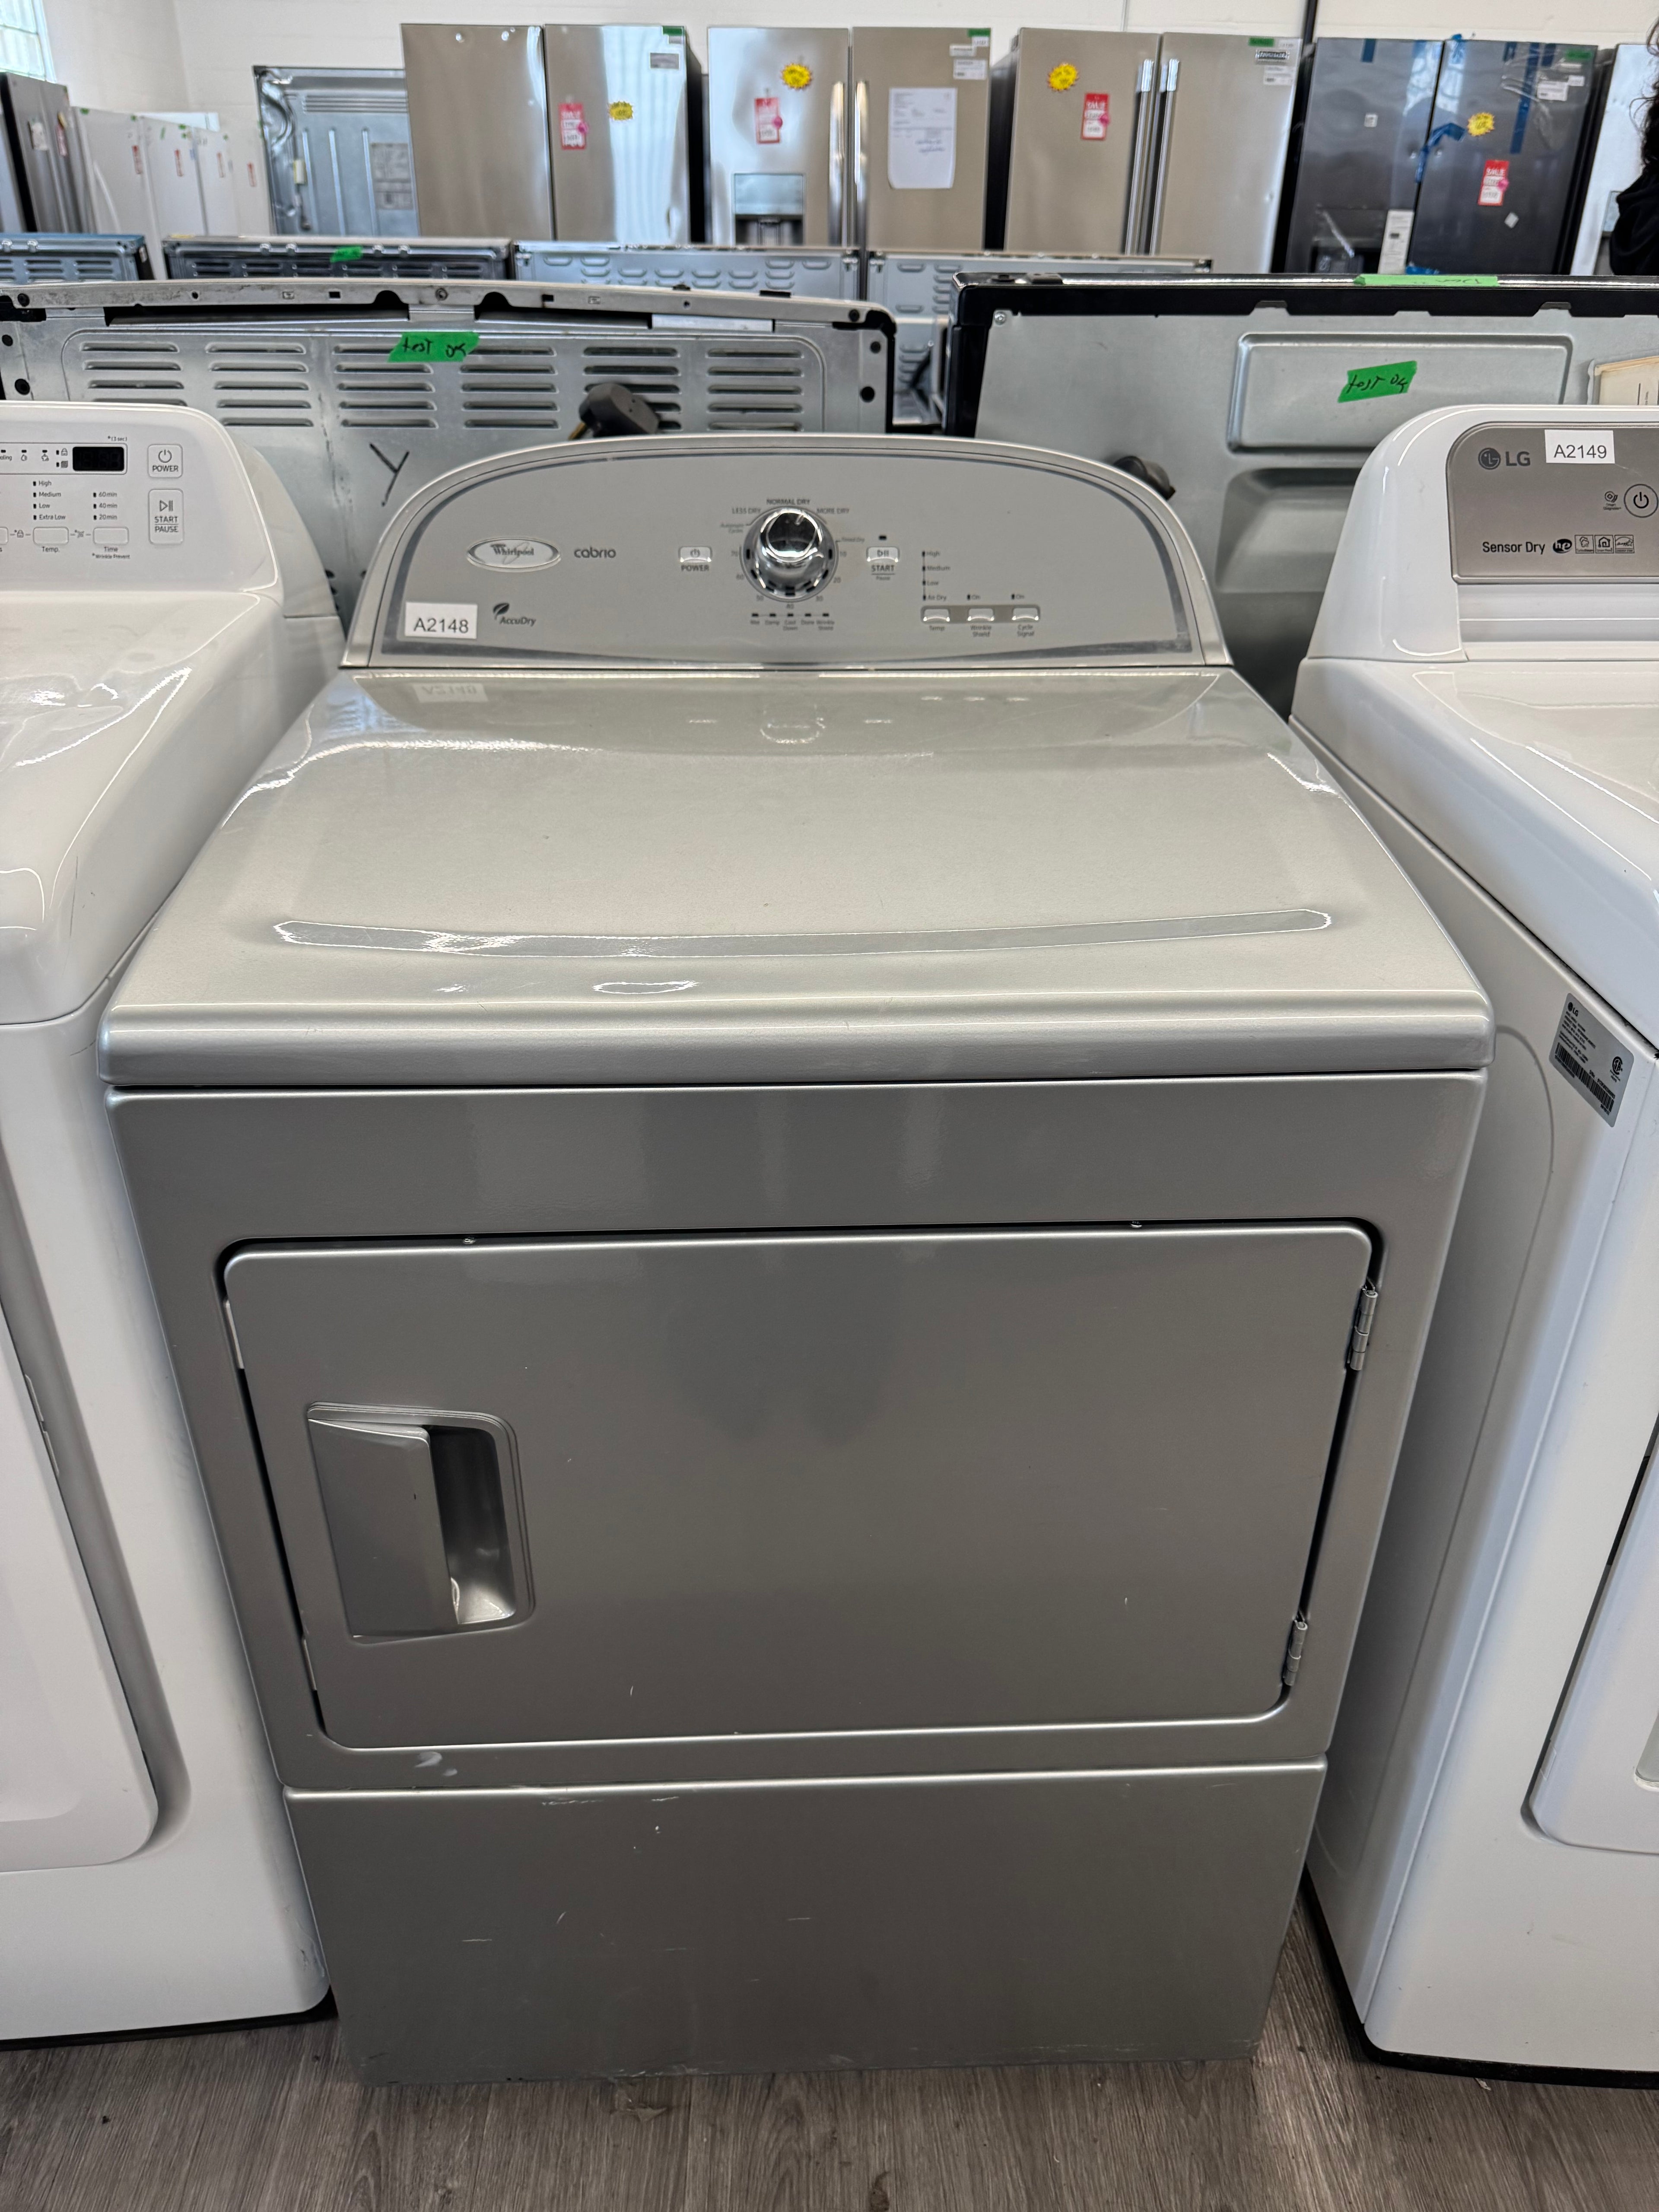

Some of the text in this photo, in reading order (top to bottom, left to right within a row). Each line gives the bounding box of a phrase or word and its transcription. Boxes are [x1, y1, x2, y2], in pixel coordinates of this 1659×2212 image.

[1506, 451, 1531, 466] LG
[1554, 445, 1607, 459] A2149
[490, 543, 616, 558] Whirlpool cabrio
[1482, 542, 1522, 553] Sensor
[1526, 542, 1545, 555] Dry
[413, 618, 469, 633] A2148
[500, 617, 537, 626] AccuDry
[1573, 1007, 1578, 1017] LG
